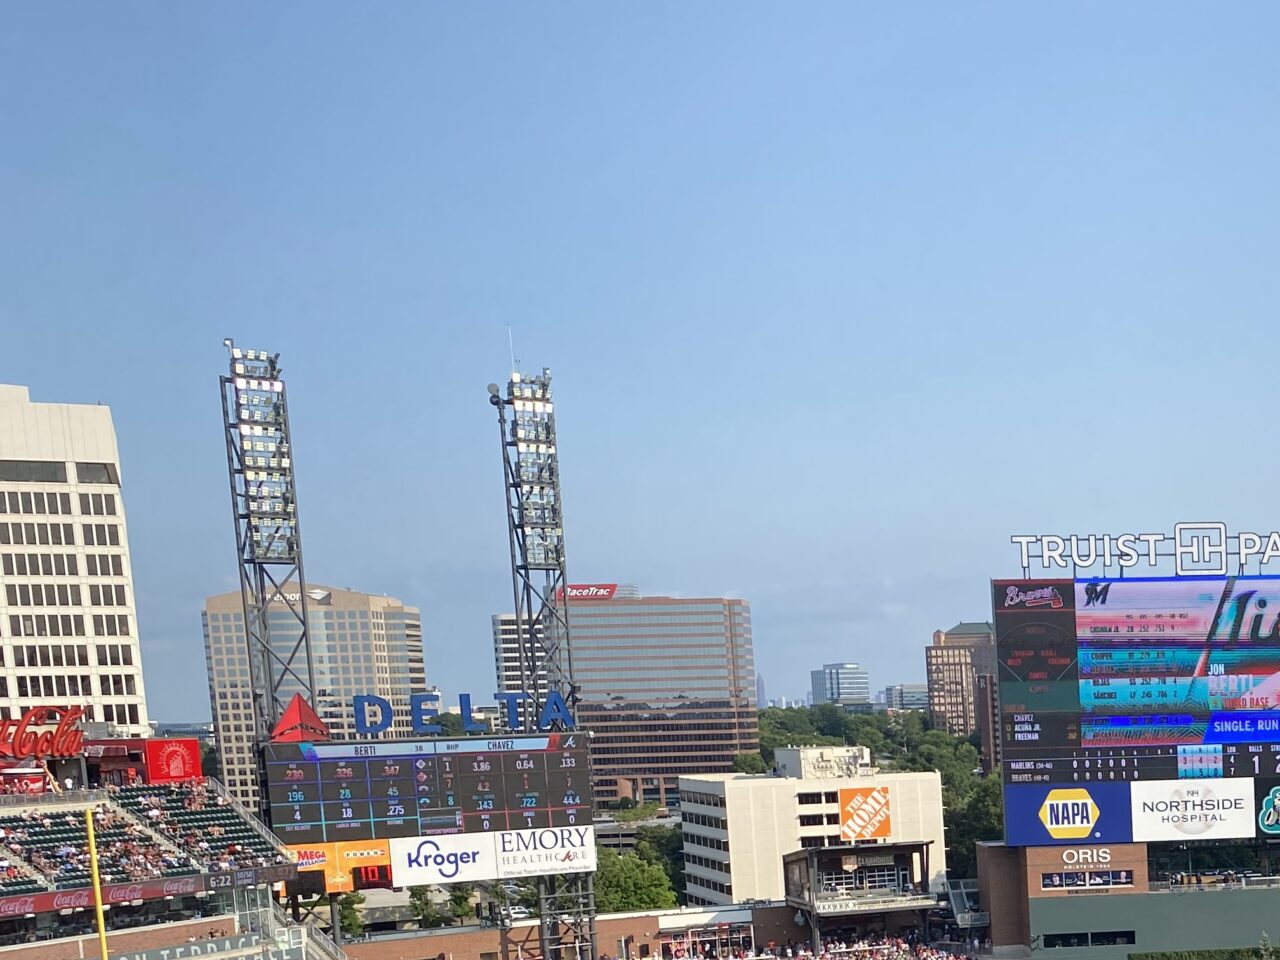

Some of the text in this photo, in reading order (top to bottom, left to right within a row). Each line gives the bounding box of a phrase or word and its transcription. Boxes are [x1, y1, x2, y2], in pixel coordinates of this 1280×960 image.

[1011, 534, 1165, 568] TRUIST
[1207, 663, 1225, 675] JON
[353, 691, 575, 735] DELTA
[1214, 719, 1279, 732] SINGLE, RUN
[1014, 732, 1039, 740] FREEMAN
[354, 745, 376, 756] BERTI
[487, 741, 514, 750] CHAVEZ
[472, 761, 491, 772] 3.86
[516, 760, 534, 770] 0.64
[1010, 761, 1035, 769] MARLINS
[1252, 755, 1260, 774] 1
[340, 789, 351, 799] 28
[387, 786, 399, 796] 45
[447, 795, 454, 805] 8
[563, 795, 580, 805] 44.4
[845, 792, 866, 814] THE
[1142, 799, 1245, 813] NORTHSIDE
[294, 805, 405, 821] 4 18 .275
[841, 787, 890, 838] HOME
[1049, 802, 1091, 825] NAPA
[1162, 813, 1227, 824] HOSPITAL
[483, 815, 575, 830] 0 0
[861, 806, 891, 838] DEPOT
[500, 827, 589, 853] EMORY
[297, 850, 327, 861] MEGA
[407, 840, 480, 878] Kroger
[502, 850, 588, 865] HEALTHCARE
[1062, 848, 1111, 864] ORIS
[164, 878, 196, 894] Coca-Cola
[209, 875, 232, 888] 6:22
[109, 885, 143, 901] Coca-Cola
